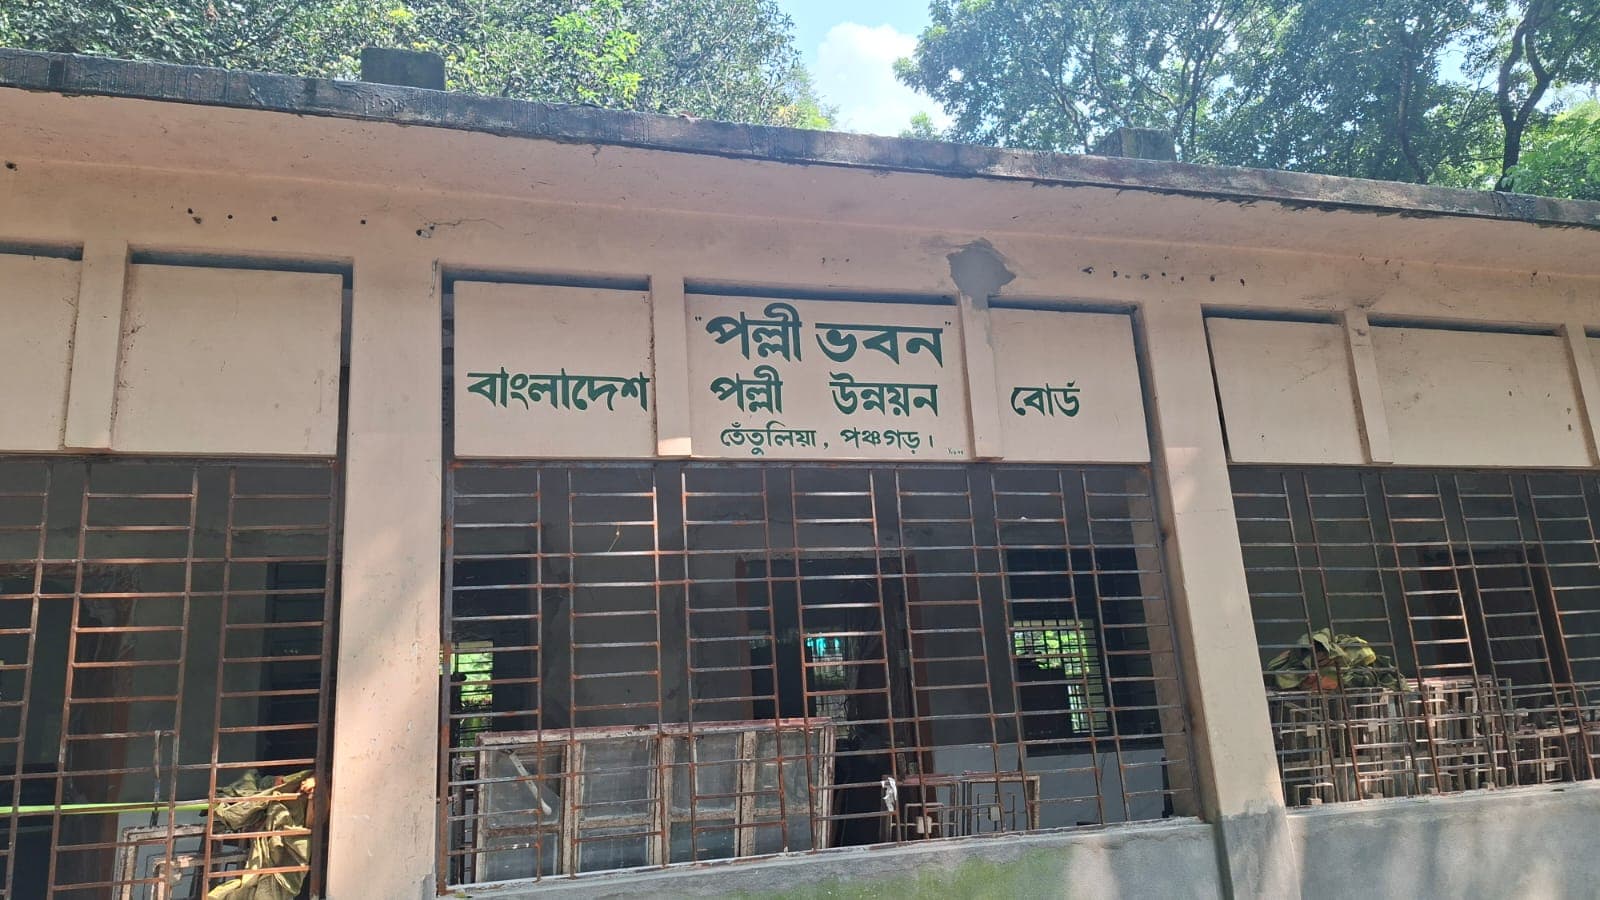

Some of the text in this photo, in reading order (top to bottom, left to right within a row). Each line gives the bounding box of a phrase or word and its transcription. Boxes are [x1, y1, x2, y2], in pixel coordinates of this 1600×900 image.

[467, 364, 1081, 417] বাংলাদেশ পল্লী উন্নয়ন বোর্ড
